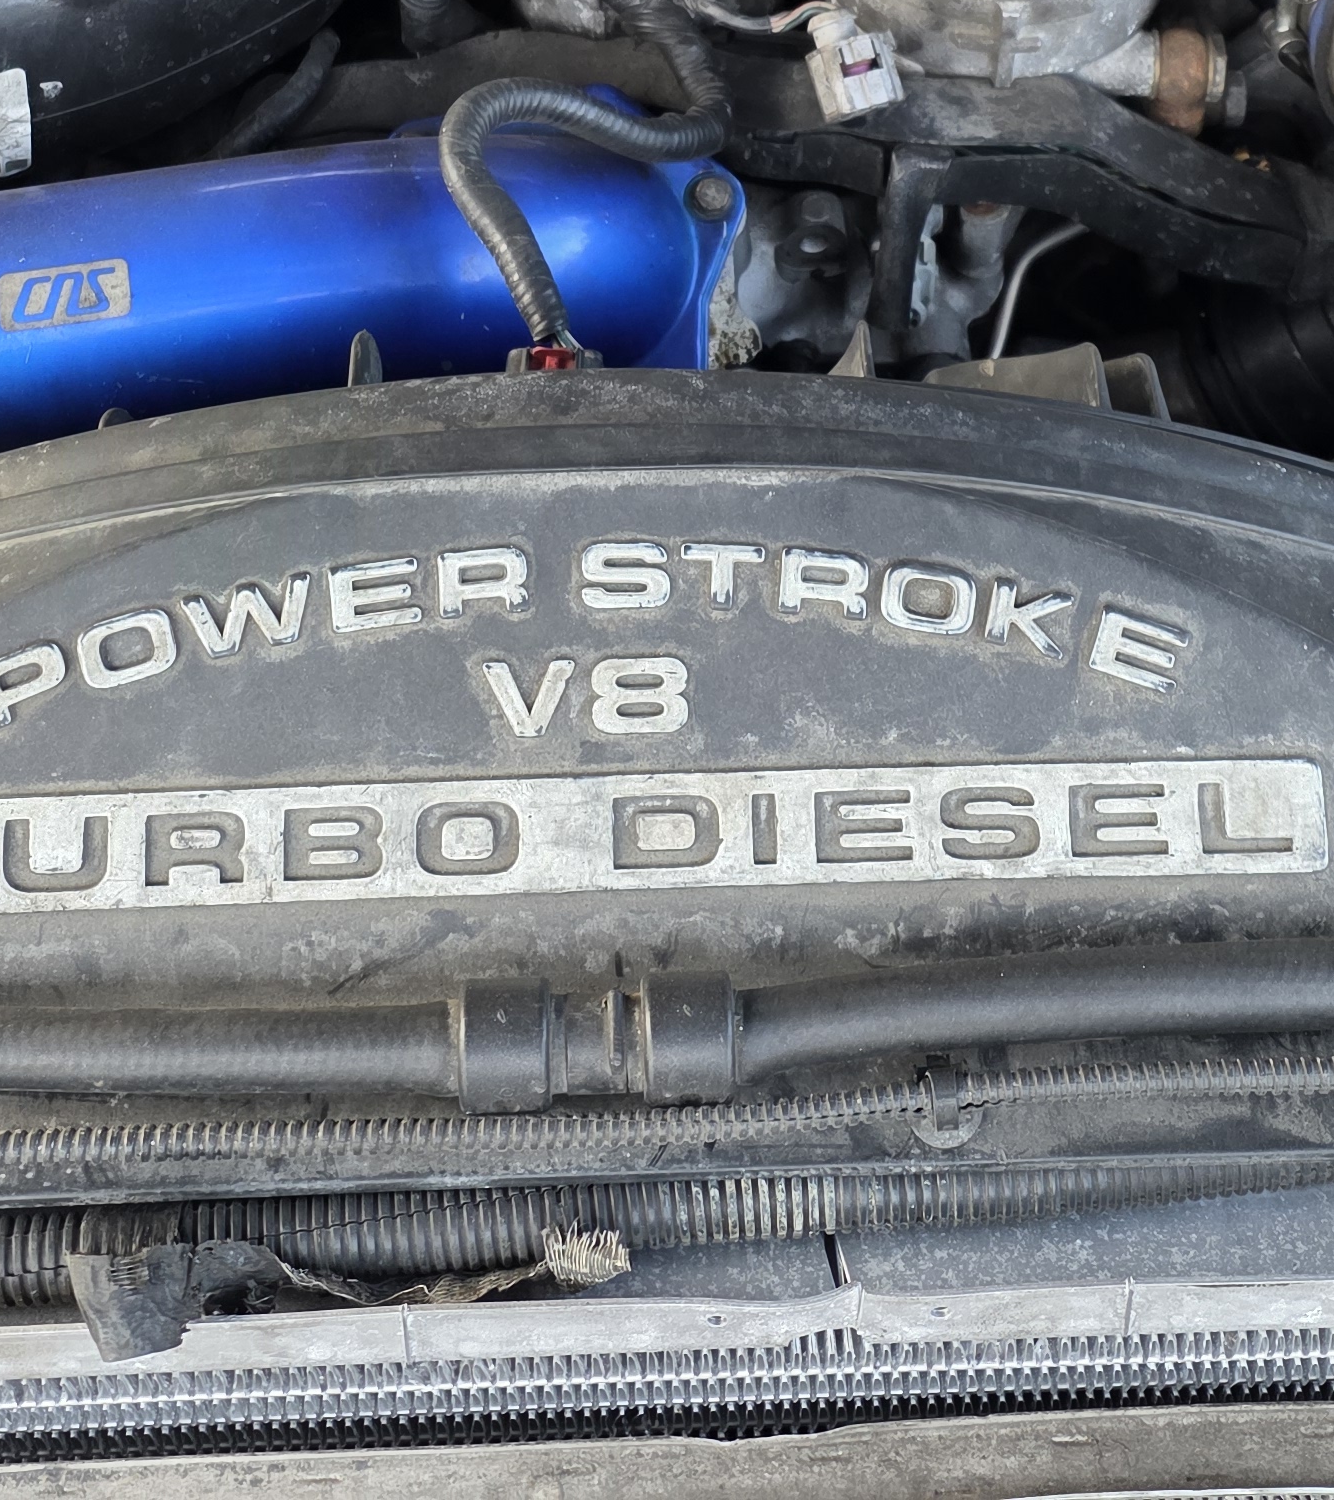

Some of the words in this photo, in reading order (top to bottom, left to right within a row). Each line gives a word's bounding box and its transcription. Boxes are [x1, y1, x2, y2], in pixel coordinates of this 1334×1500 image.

[580, 542, 1192, 694] STROKE
[482, 656, 690, 739] V8
[612, 781, 1296, 871] DIESEL
